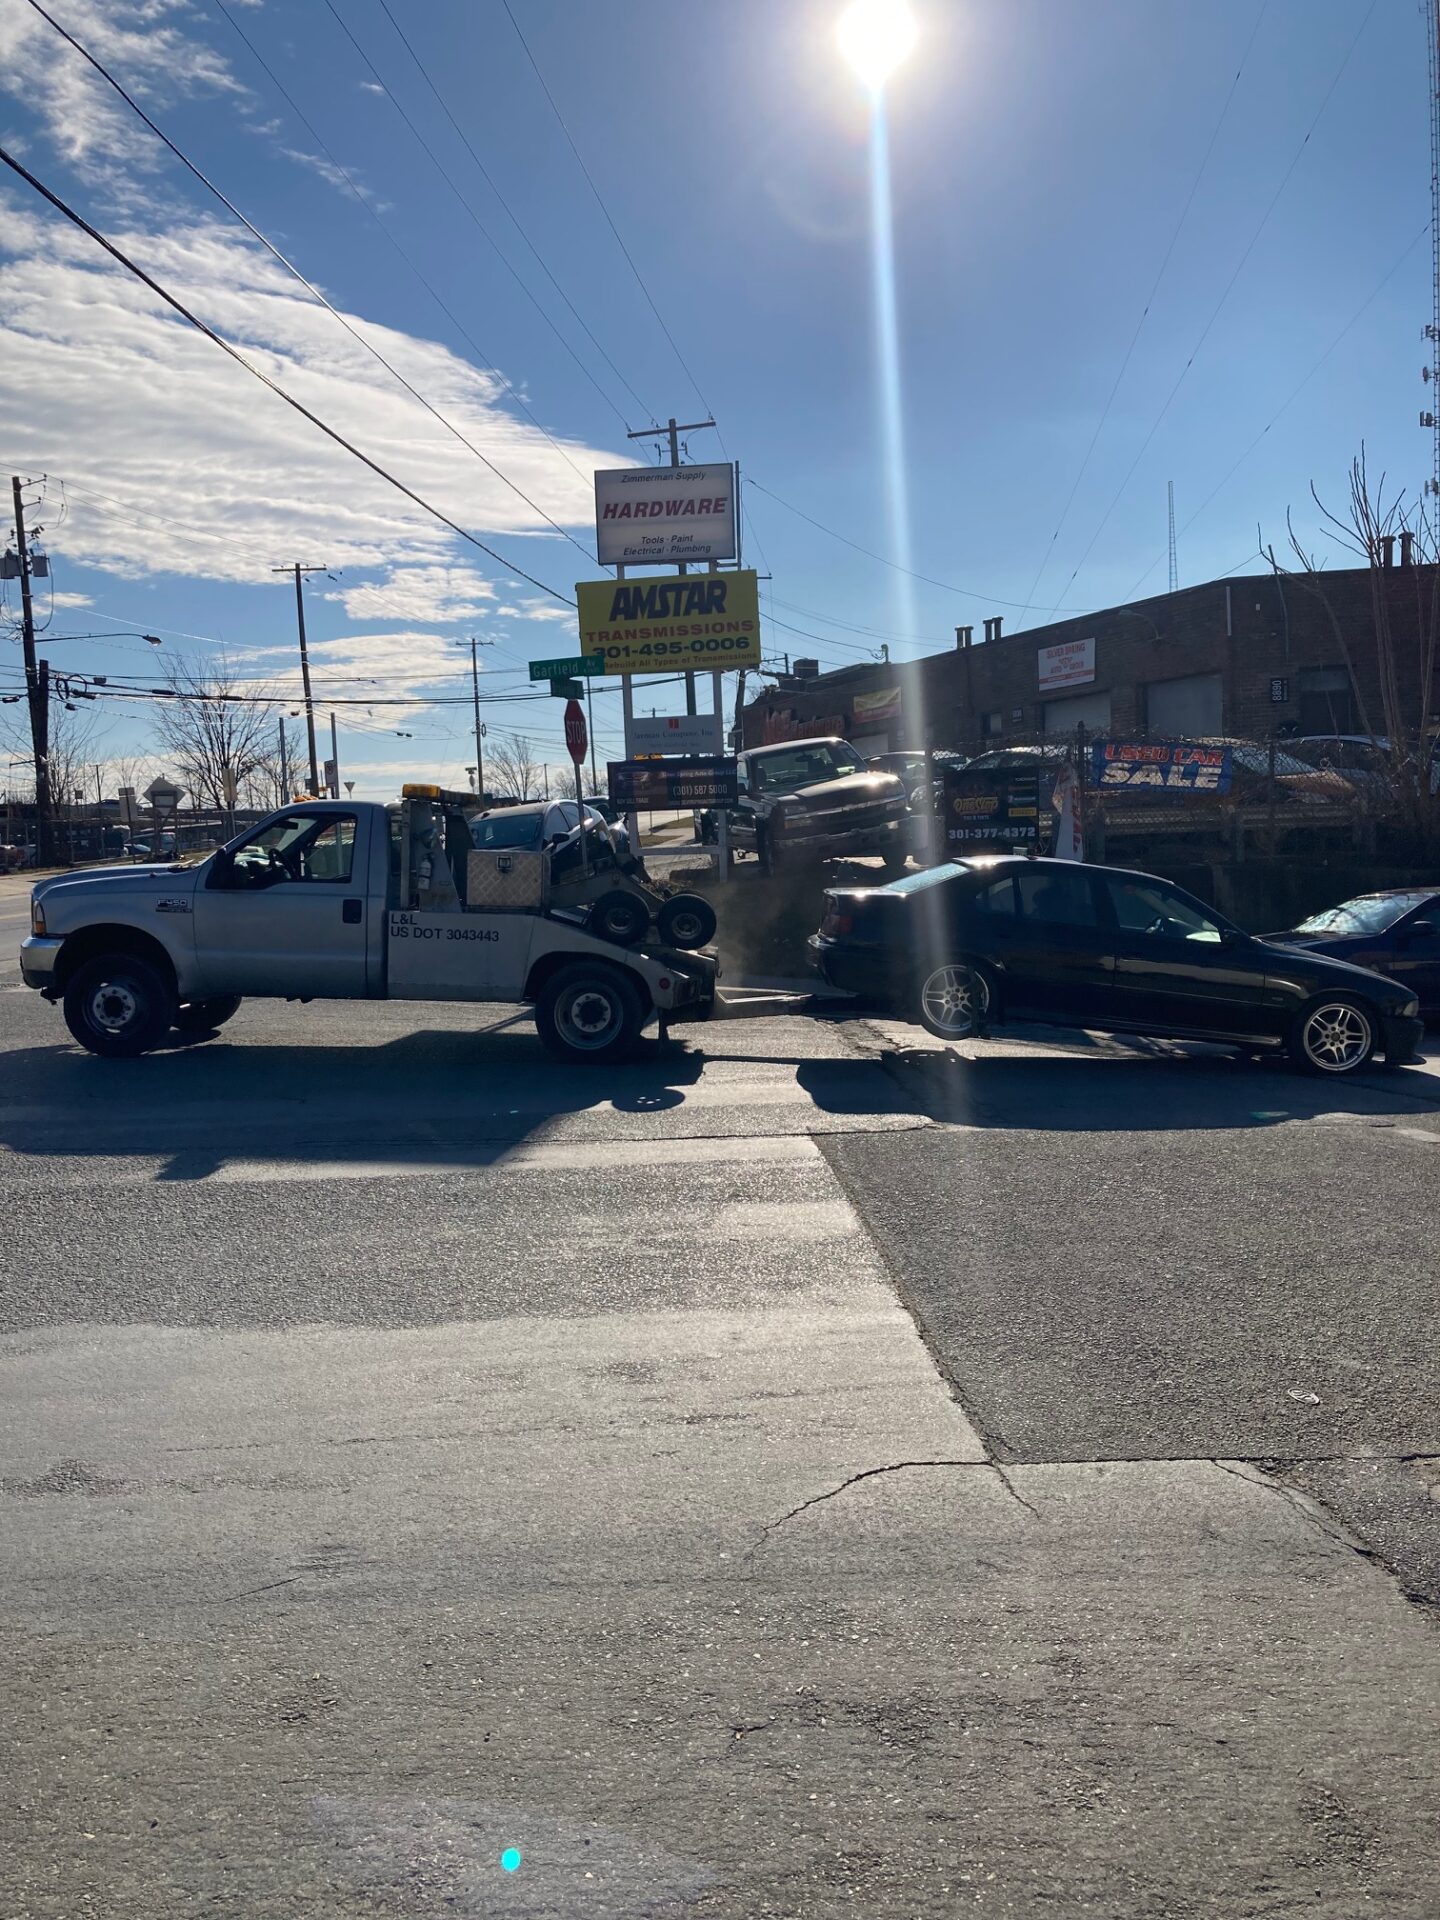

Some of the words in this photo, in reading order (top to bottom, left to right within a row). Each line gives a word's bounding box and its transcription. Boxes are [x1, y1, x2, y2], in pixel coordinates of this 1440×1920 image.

[621, 474, 673, 483] Zimmerman
[675, 471, 706, 482] Supply
[603, 497, 728, 519] HARDWARE
[642, 536, 664, 544] Tools
[671, 534, 693, 543] Paint
[624, 547, 664, 556] Electrical
[671, 545, 711, 554] Plumbing
[609, 580, 727, 622] AMSTAR
[586, 620, 754, 643] TRANSMISSIONS
[593, 636, 750, 660] 301-495-0006
[639, 658, 651, 668] All
[654, 657, 678, 667] Types
[681, 656, 691, 664] of
[693, 652, 757, 663] Transmissions
[533, 662, 579, 678] Garfield
[566, 721, 586, 744] STOP
[1105, 744, 1168, 761] USED
[1173, 748, 1224, 765] CAR
[1100, 762, 1222, 788] SALE
[672, 785, 693, 796] (301)
[694, 785, 707, 795] 587
[708, 784, 728, 794] 5000
[949, 827, 1036, 839] 301-377-4372
[391, 913, 418, 926] L&L
[391, 926, 409, 938] US
[413, 927, 443, 940] DOT
[447, 929, 500, 942] 3043443
